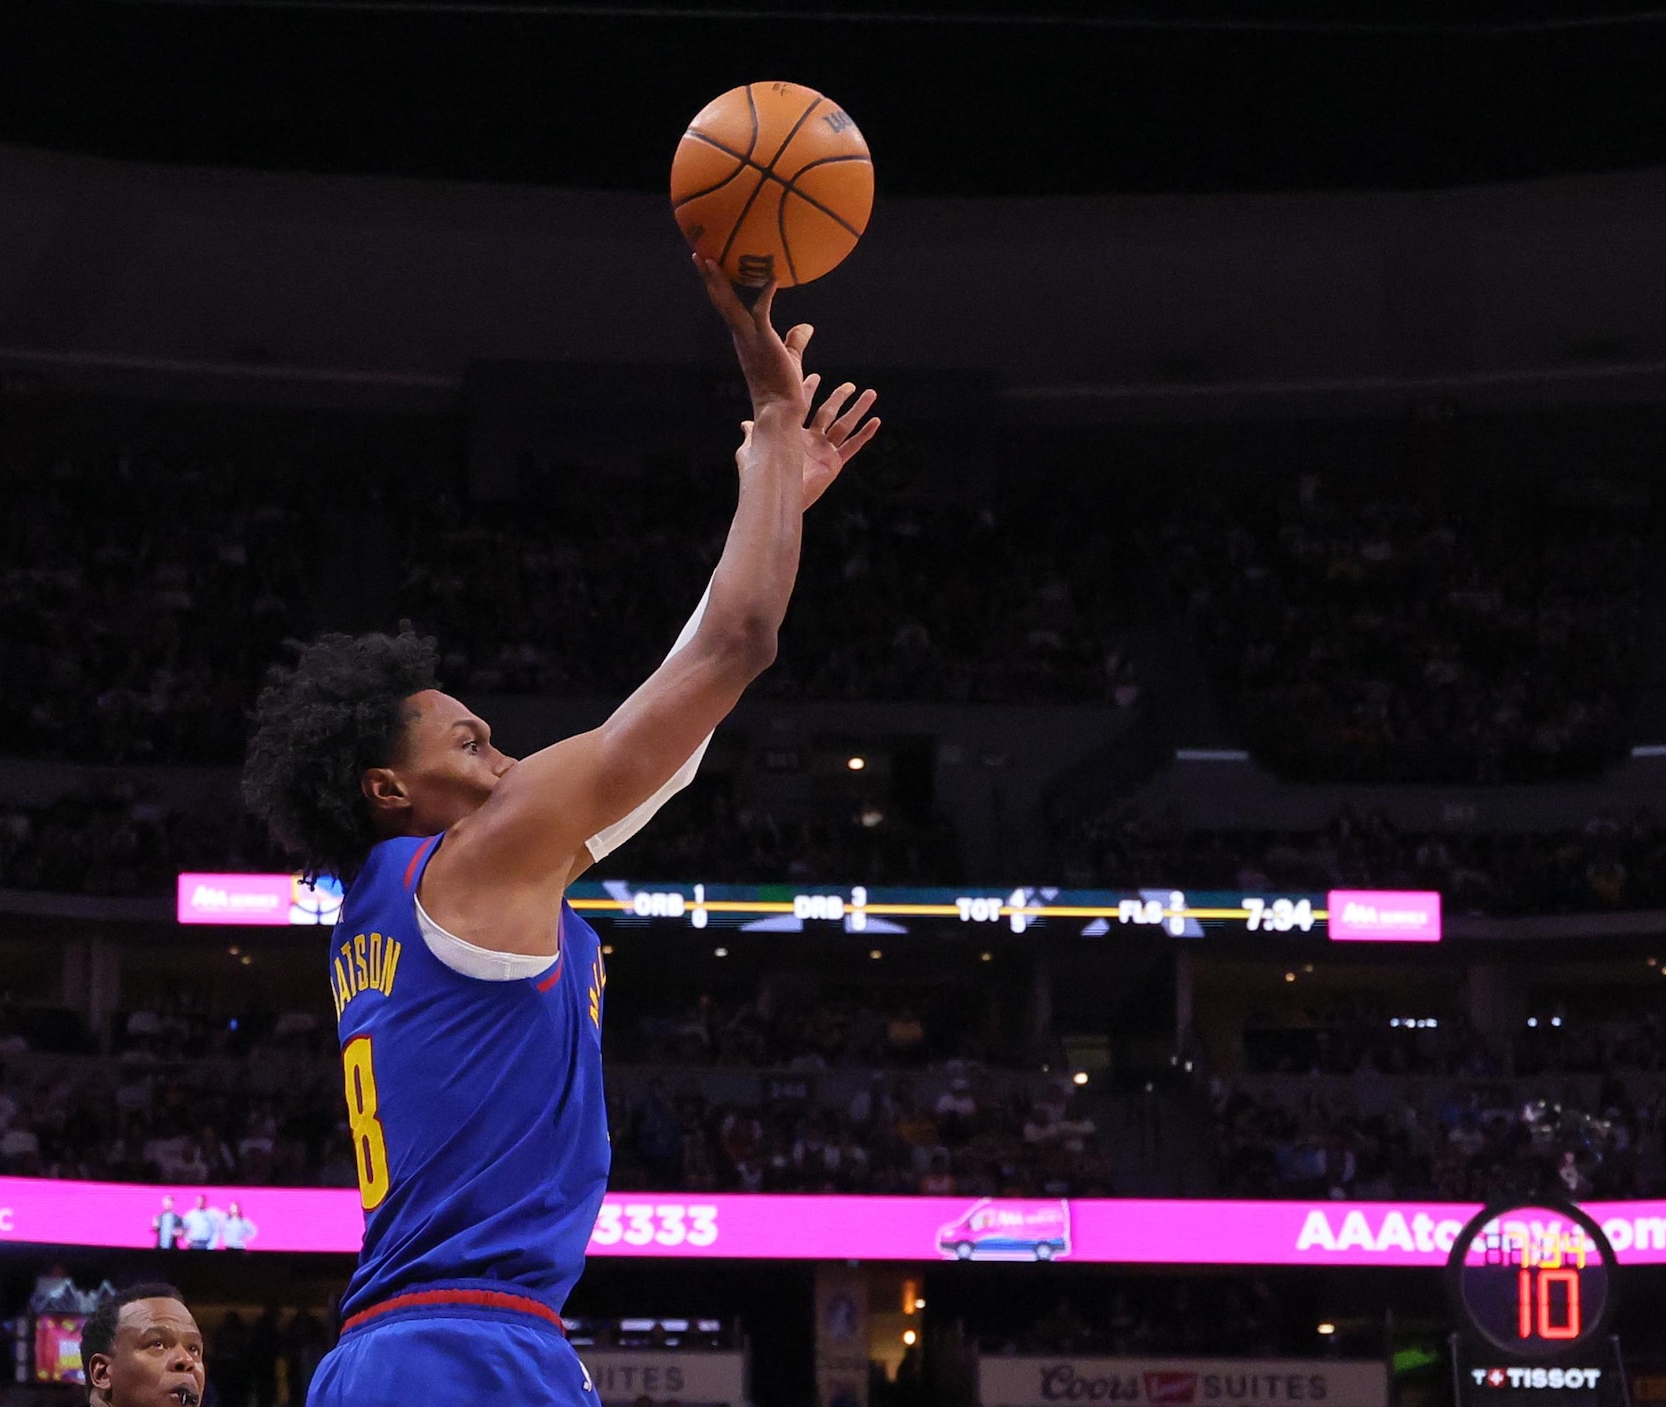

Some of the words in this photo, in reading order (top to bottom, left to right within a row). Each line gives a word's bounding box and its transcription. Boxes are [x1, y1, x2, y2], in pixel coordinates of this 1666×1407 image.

[955, 897, 1003, 923] TOT
[1118, 900, 1163, 925] FLS
[1241, 897, 1315, 933] 7:34
[330, 932, 402, 1022] ATSON
[342, 1033, 391, 1214] 8
[1517, 1268, 1582, 1340] 10
[1039, 1363, 1140, 1401] Coors
[1202, 1373, 1328, 1400] SUITES
[1506, 1367, 1601, 1390] TISSOT
